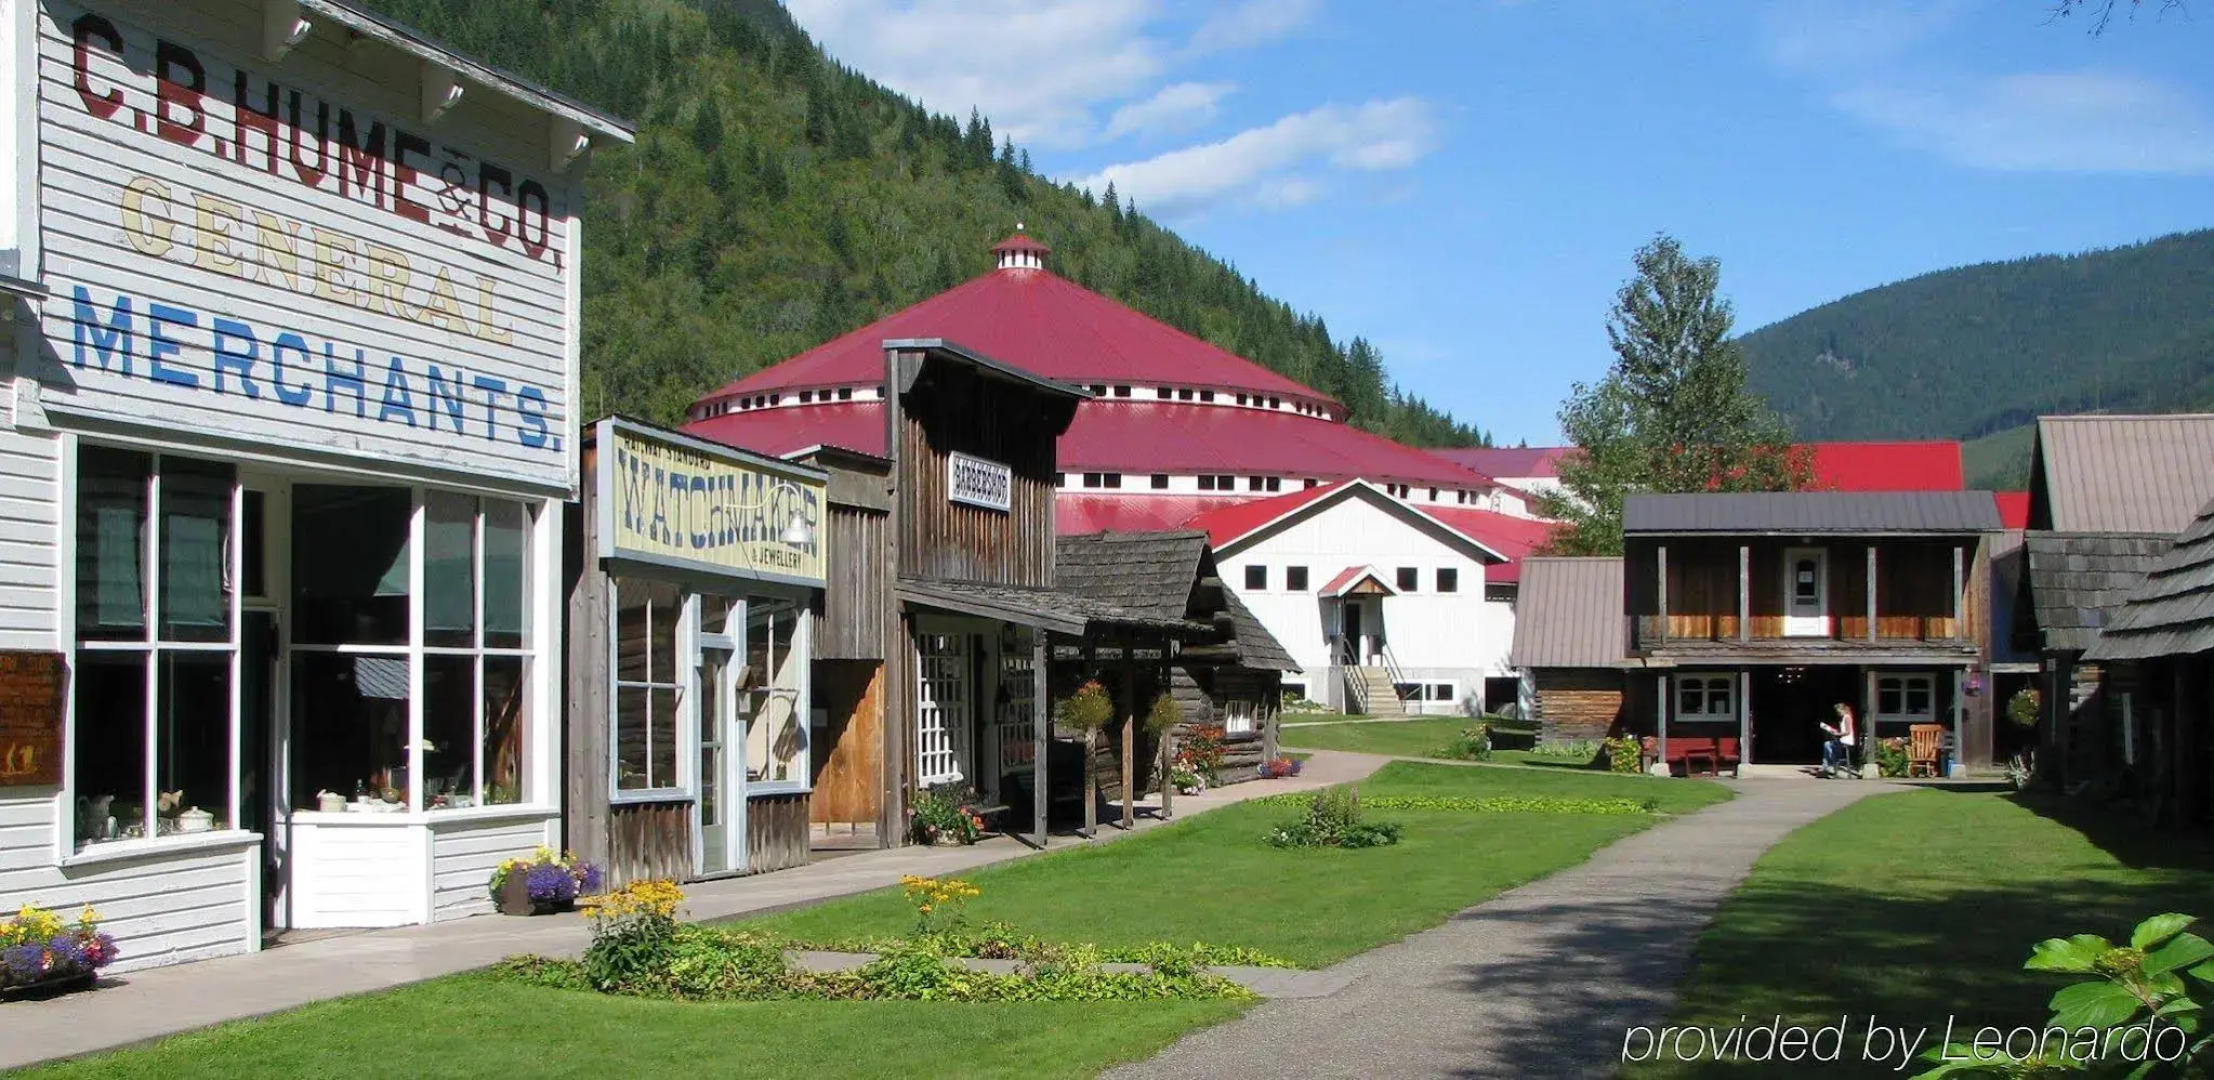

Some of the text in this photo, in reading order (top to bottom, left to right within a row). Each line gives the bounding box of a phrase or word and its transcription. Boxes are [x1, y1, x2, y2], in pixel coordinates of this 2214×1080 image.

[120, 176, 514, 346] GENERAL
[73, 285, 563, 453] MERCHANTS.
[955, 463, 1007, 498] BARBERSHOP
